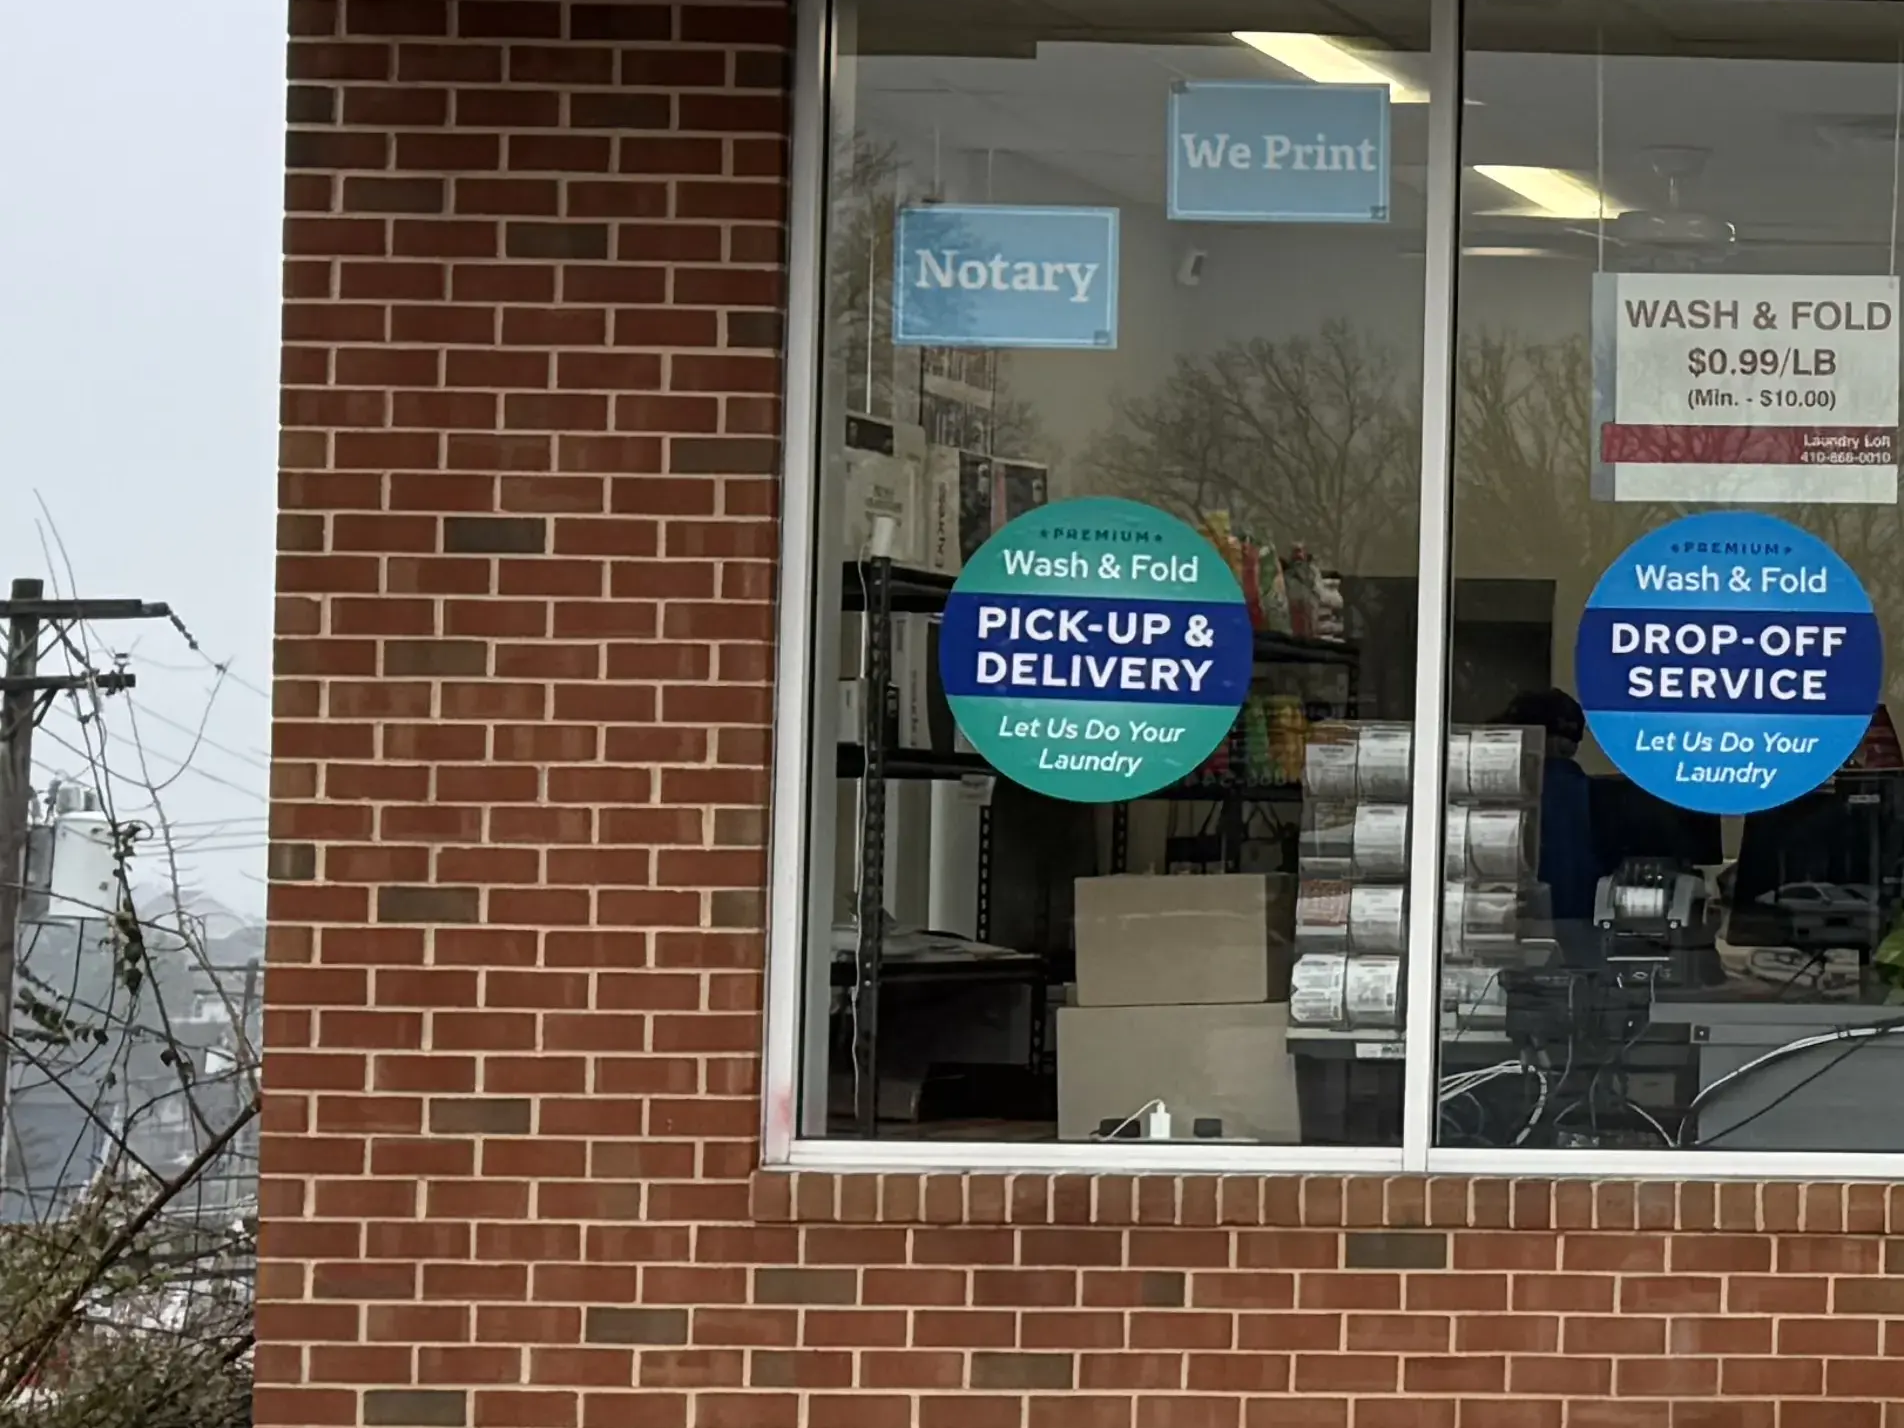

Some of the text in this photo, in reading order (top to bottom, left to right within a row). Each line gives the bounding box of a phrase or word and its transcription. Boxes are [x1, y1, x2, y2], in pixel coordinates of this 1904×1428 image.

[1181, 134, 1377, 172] We Print
[915, 249, 1099, 303] Notary
[1625, 300, 1892, 331] WASH & FOLD
[1688, 346, 1837, 379] $0.99/LB
[1688, 388, 1739, 410] (Min.
[1760, 389, 1836, 411] $10.00)
[1804, 433, 1891, 450] Laundry Loft
[1053, 528, 1150, 543] PREMIUM
[1684, 541, 1780, 555] PREMIUM
[1003, 549, 1199, 583] Wash & Fold
[1635, 564, 1828, 594] Wash & Fold
[977, 606, 1214, 648] PICK-UP &
[1611, 622, 1847, 657] DROP-OFF
[976, 651, 1214, 692] DELIVERY
[1628, 665, 1827, 701] SERVICE
[999, 715, 1186, 743] Let Us Do Your
[1635, 729, 1819, 754] Let Us Do Your
[1039, 748, 1143, 777] Laundry
[1675, 761, 1778, 789] Laundry
